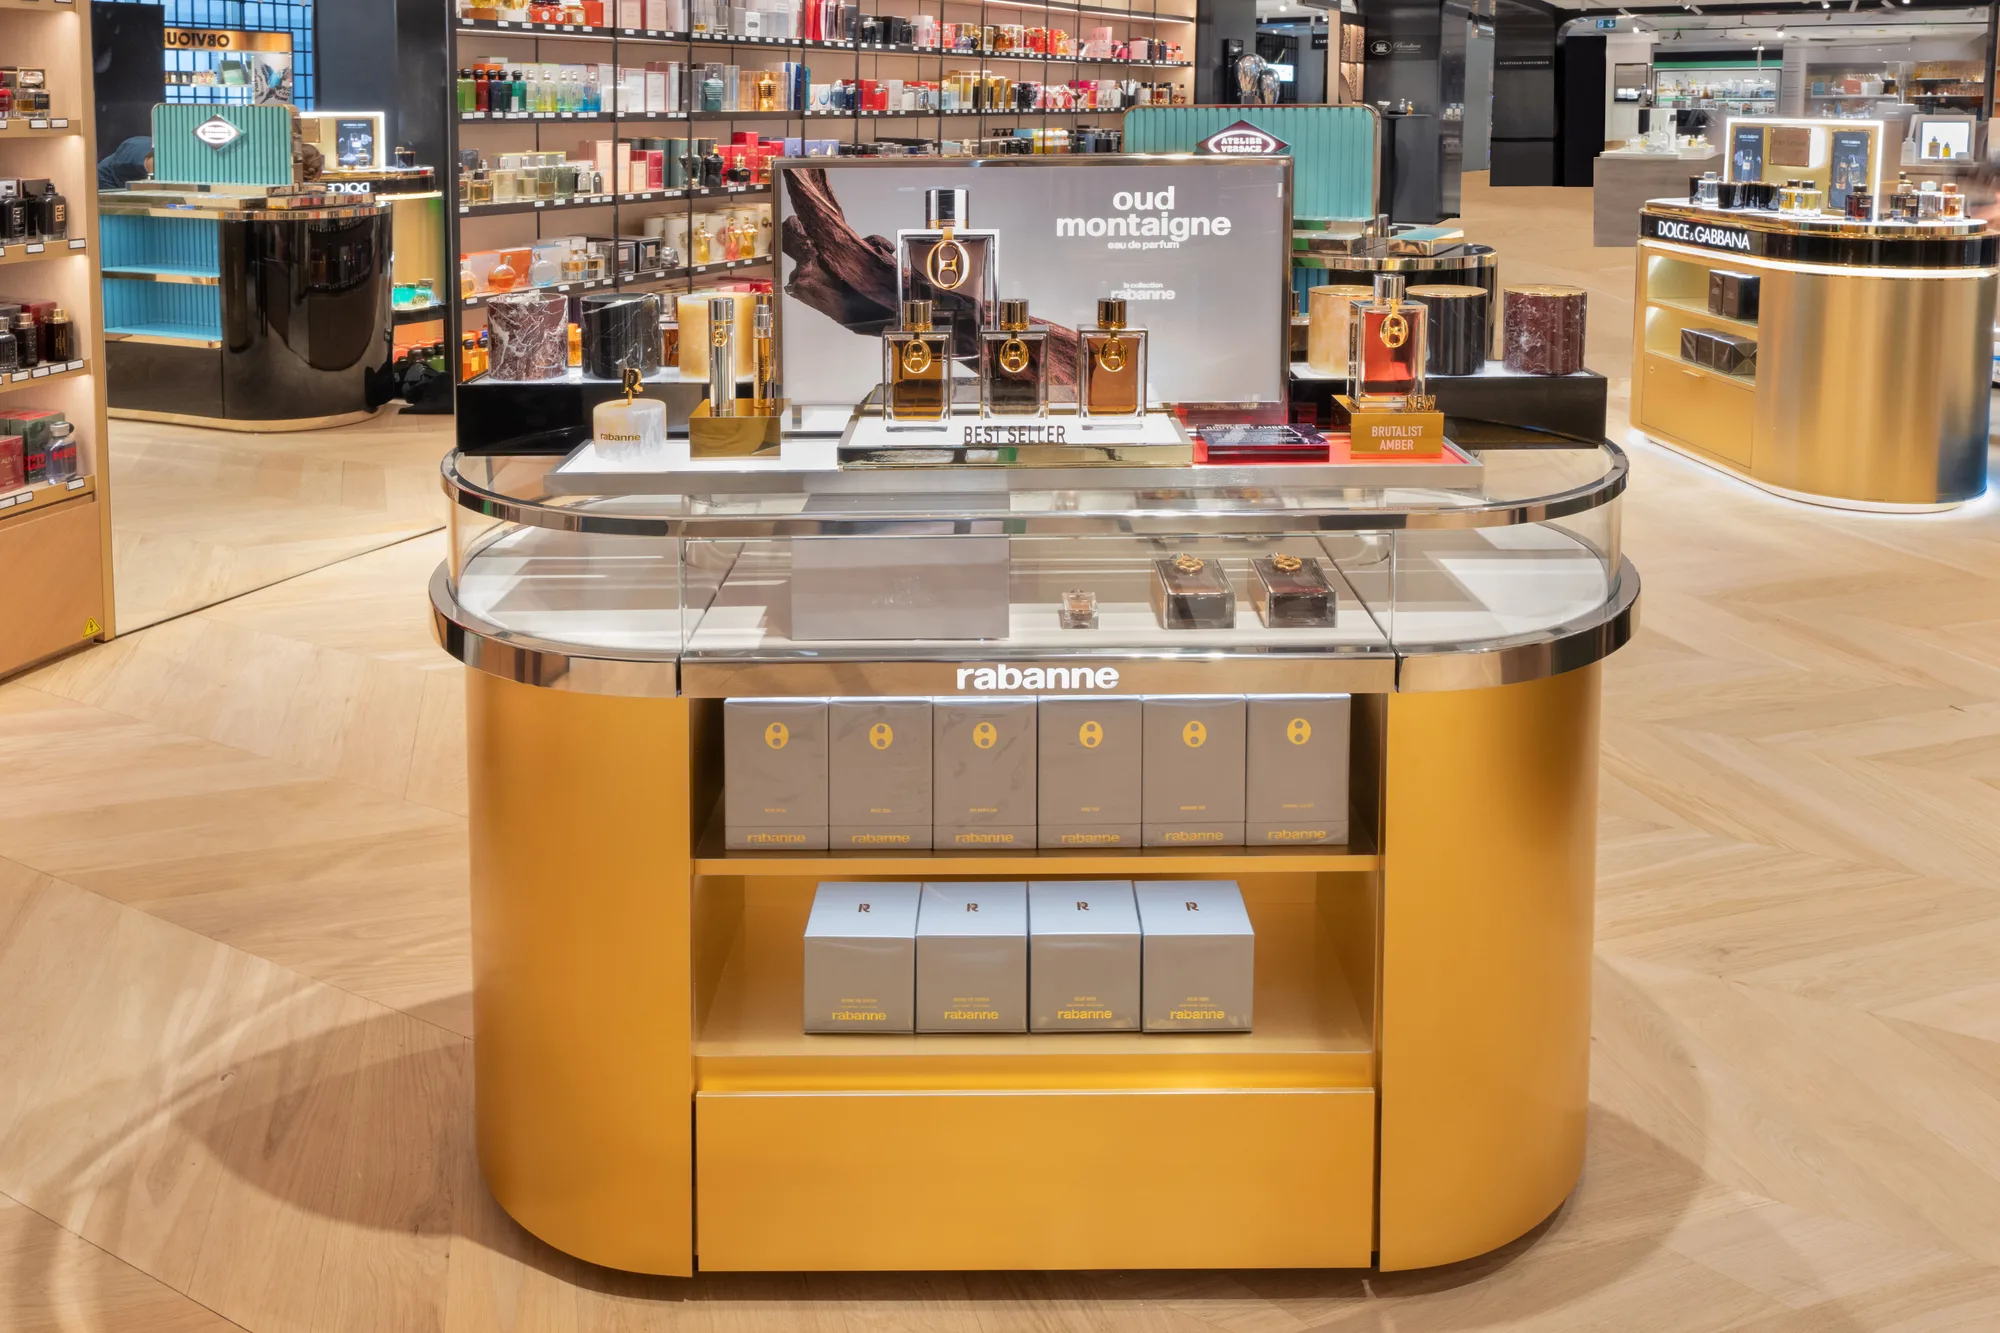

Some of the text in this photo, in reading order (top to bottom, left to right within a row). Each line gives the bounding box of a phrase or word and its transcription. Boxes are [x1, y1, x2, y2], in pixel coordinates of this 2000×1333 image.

[1221, 137, 1262, 145] ATELIER
[1221, 145, 1262, 153] VERSACE
[1112, 185, 1175, 211] oud
[1056, 211, 1232, 242] montaigne
[1107, 240, 1180, 250] eau de parfum
[1110, 288, 1176, 300] rabanne
[1406, 394, 1436, 411] NEW
[964, 425, 1066, 444] BEST SELLER
[1371, 426, 1424, 437] BRUTALIST
[600, 433, 641, 442] rabanne
[1379, 439, 1414, 451] AMBER
[956, 663, 1120, 690] rabanne
[747, 833, 806, 843] rabanne
[851, 833, 910, 843] rabanne
[955, 833, 1015, 843] rabanne
[1061, 833, 1120, 843] rabanne
[1165, 831, 1224, 841] rabanne
[1267, 829, 1326, 840] rabanne
[831, 1011, 887, 1021] rabanne
[944, 1010, 999, 1020] rabanne
[1057, 1009, 1113, 1019] rabanne
[1170, 1009, 1225, 1020] rabanne
